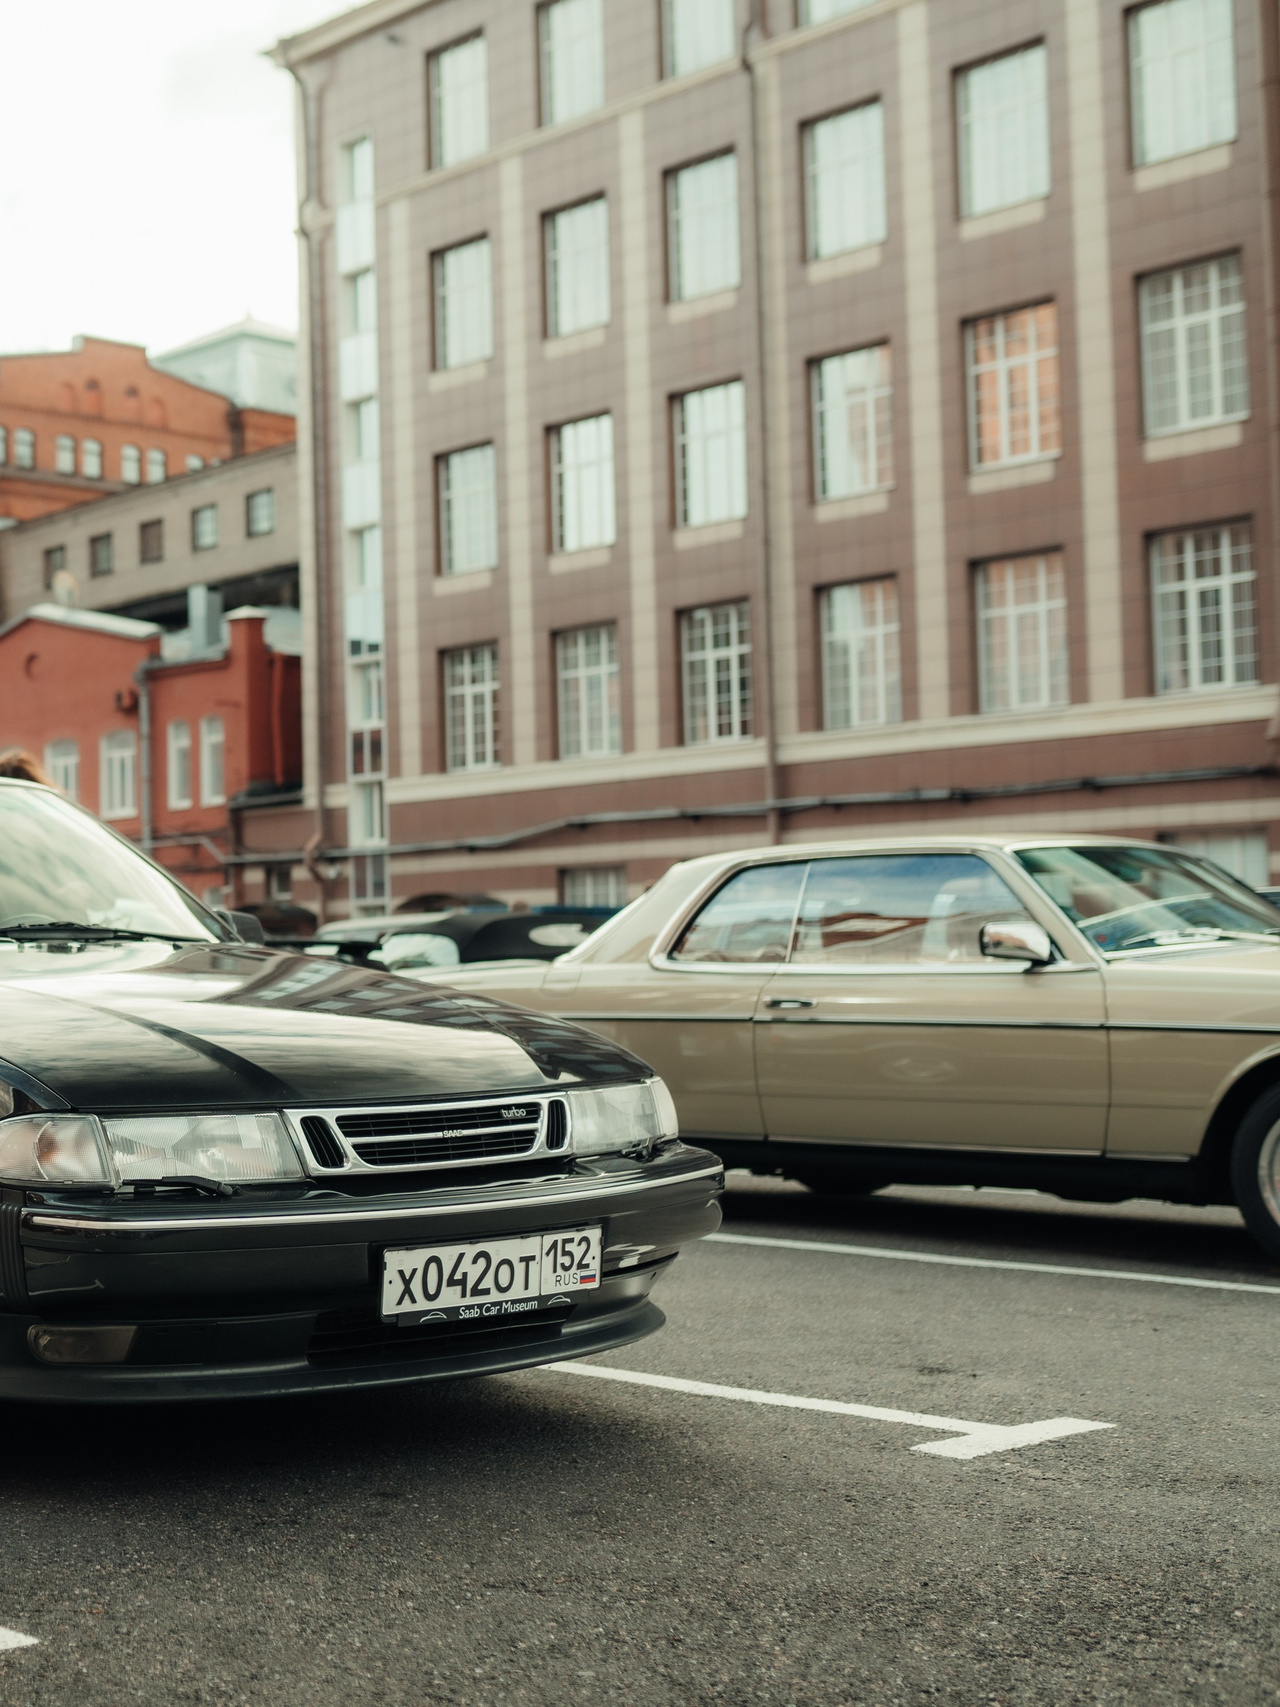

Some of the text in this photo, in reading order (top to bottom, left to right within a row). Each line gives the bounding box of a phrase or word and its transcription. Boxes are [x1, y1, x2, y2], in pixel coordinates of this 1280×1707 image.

[501, 1105, 527, 1118] turbo
[545, 1236, 591, 1274] 152
[555, 1272, 579, 1287] RUS
[458, 1300, 538, 1319] Saab Car Museum
